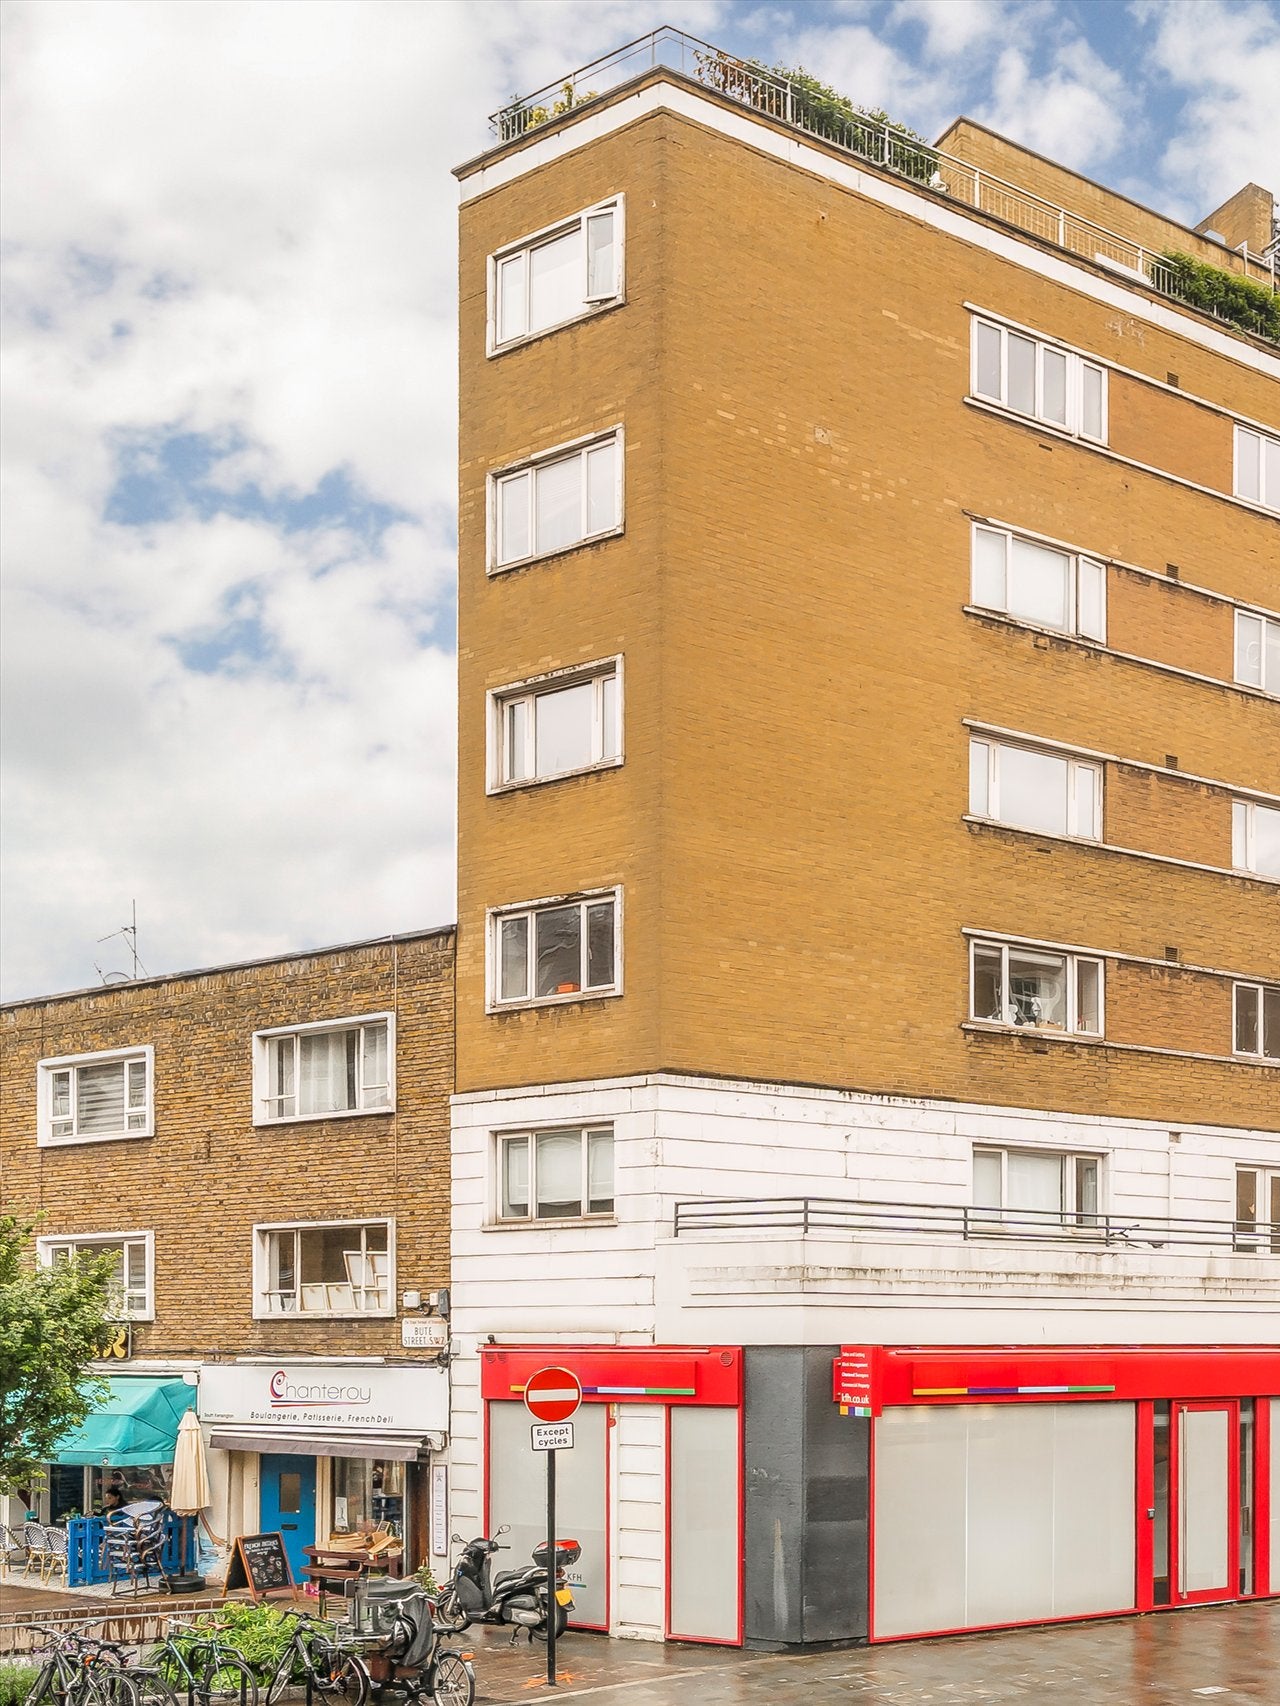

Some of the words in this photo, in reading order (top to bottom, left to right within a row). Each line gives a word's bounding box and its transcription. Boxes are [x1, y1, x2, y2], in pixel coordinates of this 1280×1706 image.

[414, 1326, 432, 1336] BUTE
[403, 1336, 426, 1346] STREET
[269, 1370, 371, 1404] Chanteroy
[842, 1393, 870, 1403] kfh.co.uk
[250, 1411, 299, 1421] Boulangerie,
[303, 1412, 345, 1423] Patisserie,
[536, 1427, 569, 1437] Except
[538, 1437, 568, 1447] cycles
[567, 1573, 582, 1582] KFH
